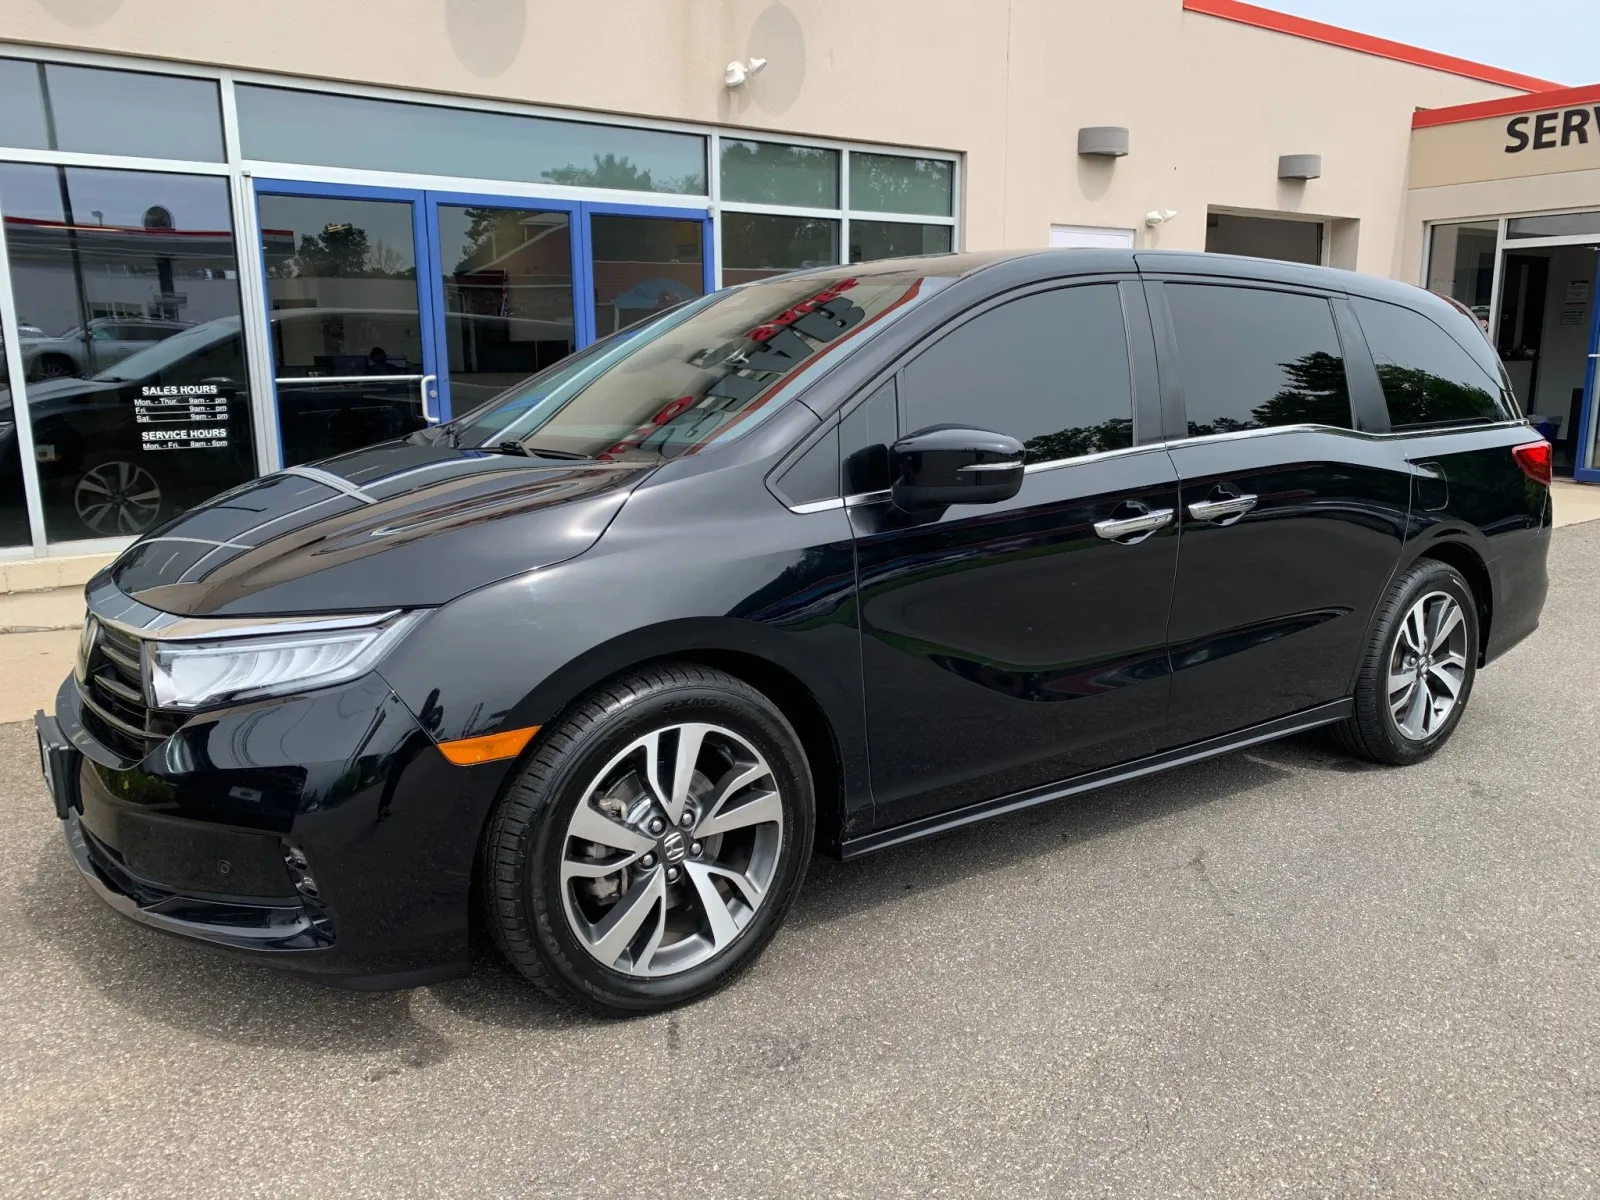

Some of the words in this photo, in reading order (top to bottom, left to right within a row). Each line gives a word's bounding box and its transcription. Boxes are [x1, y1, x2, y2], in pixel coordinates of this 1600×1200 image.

[1504, 106, 1600, 153] SER
[142, 386, 178, 395] SALES
[180, 385, 217, 394] HOURS
[142, 430, 188, 440] SERVICE
[190, 428, 227, 438] HOURS
